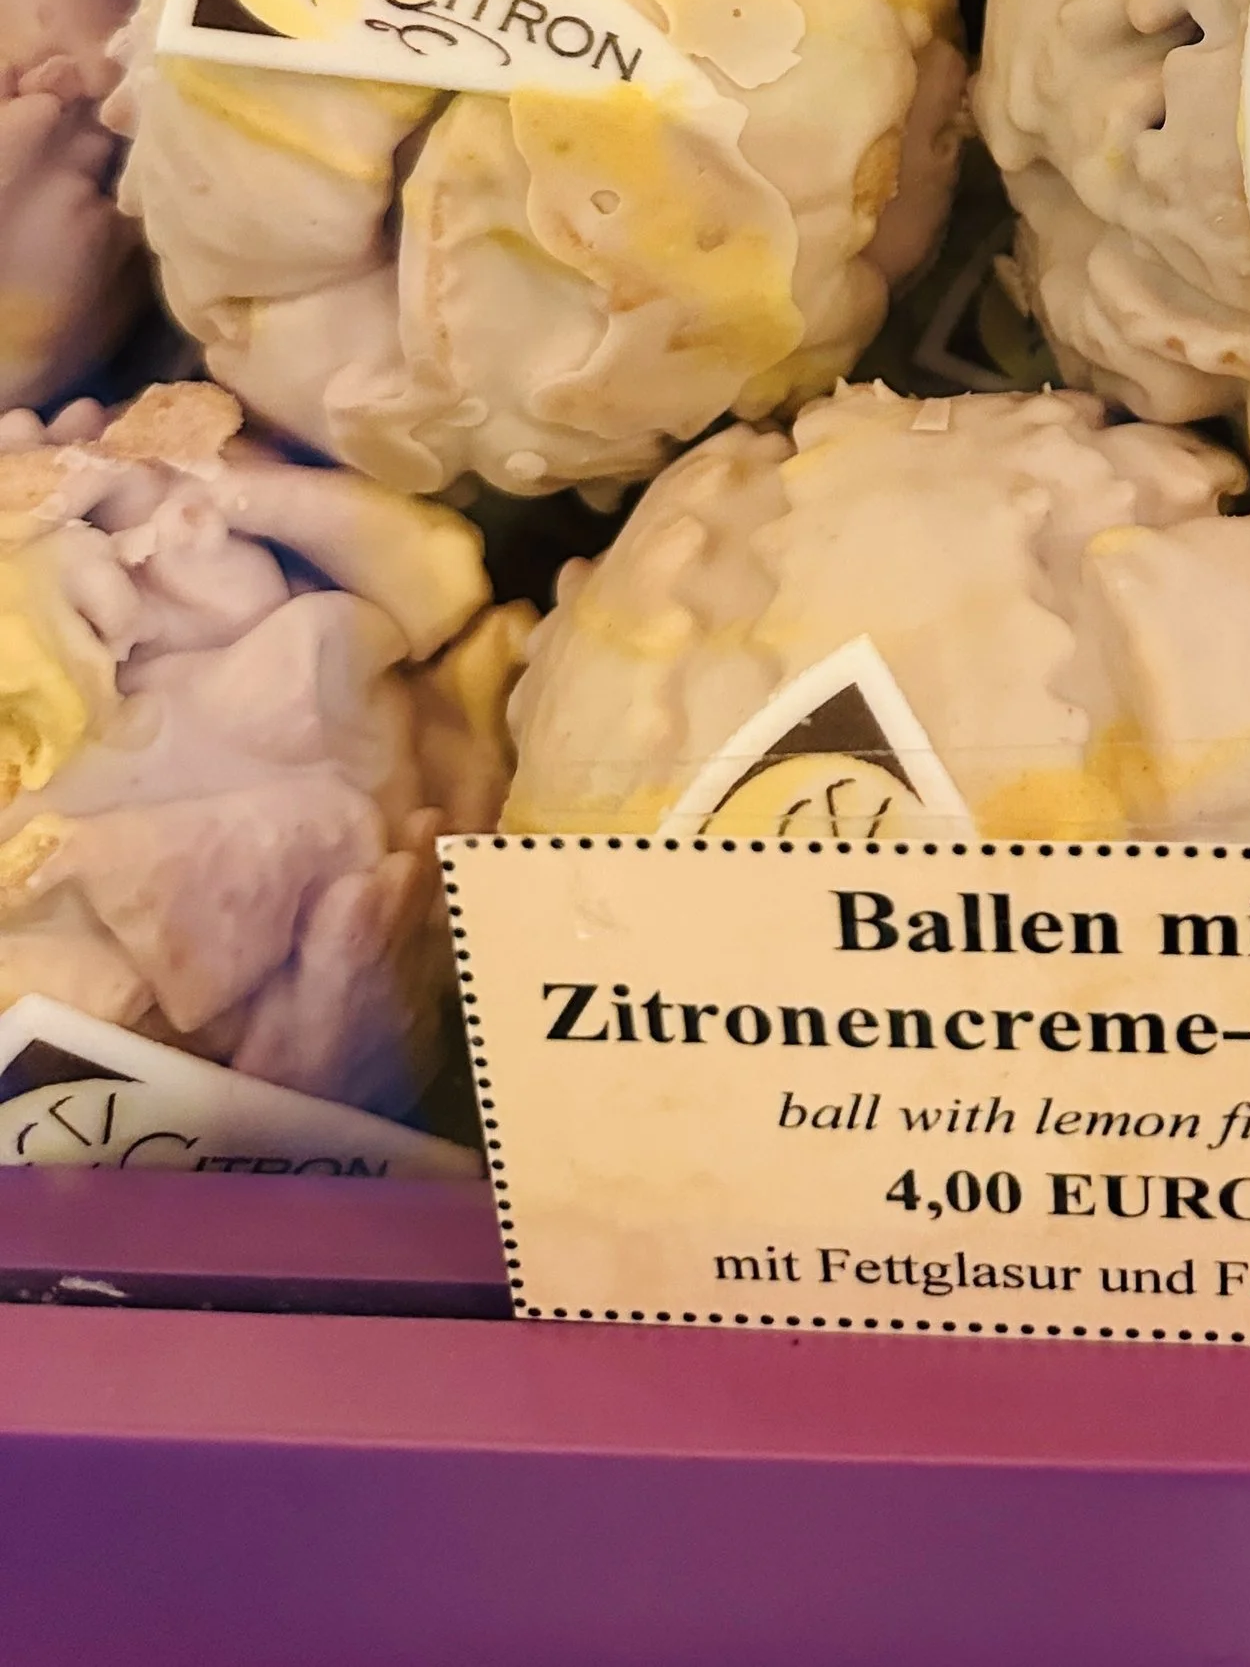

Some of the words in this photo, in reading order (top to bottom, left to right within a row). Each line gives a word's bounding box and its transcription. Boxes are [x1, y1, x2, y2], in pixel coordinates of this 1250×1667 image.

[832, 891, 1122, 954] Ballen
[779, 1093, 880, 1130] ball
[902, 1097, 1014, 1133] with
[1036, 1098, 1199, 1138] lemon
[886, 1170, 1021, 1219] 4,00
[715, 1246, 800, 1281] mit
[819, 1249, 1081, 1296] Fettglasur
[1101, 1260, 1195, 1294] und
